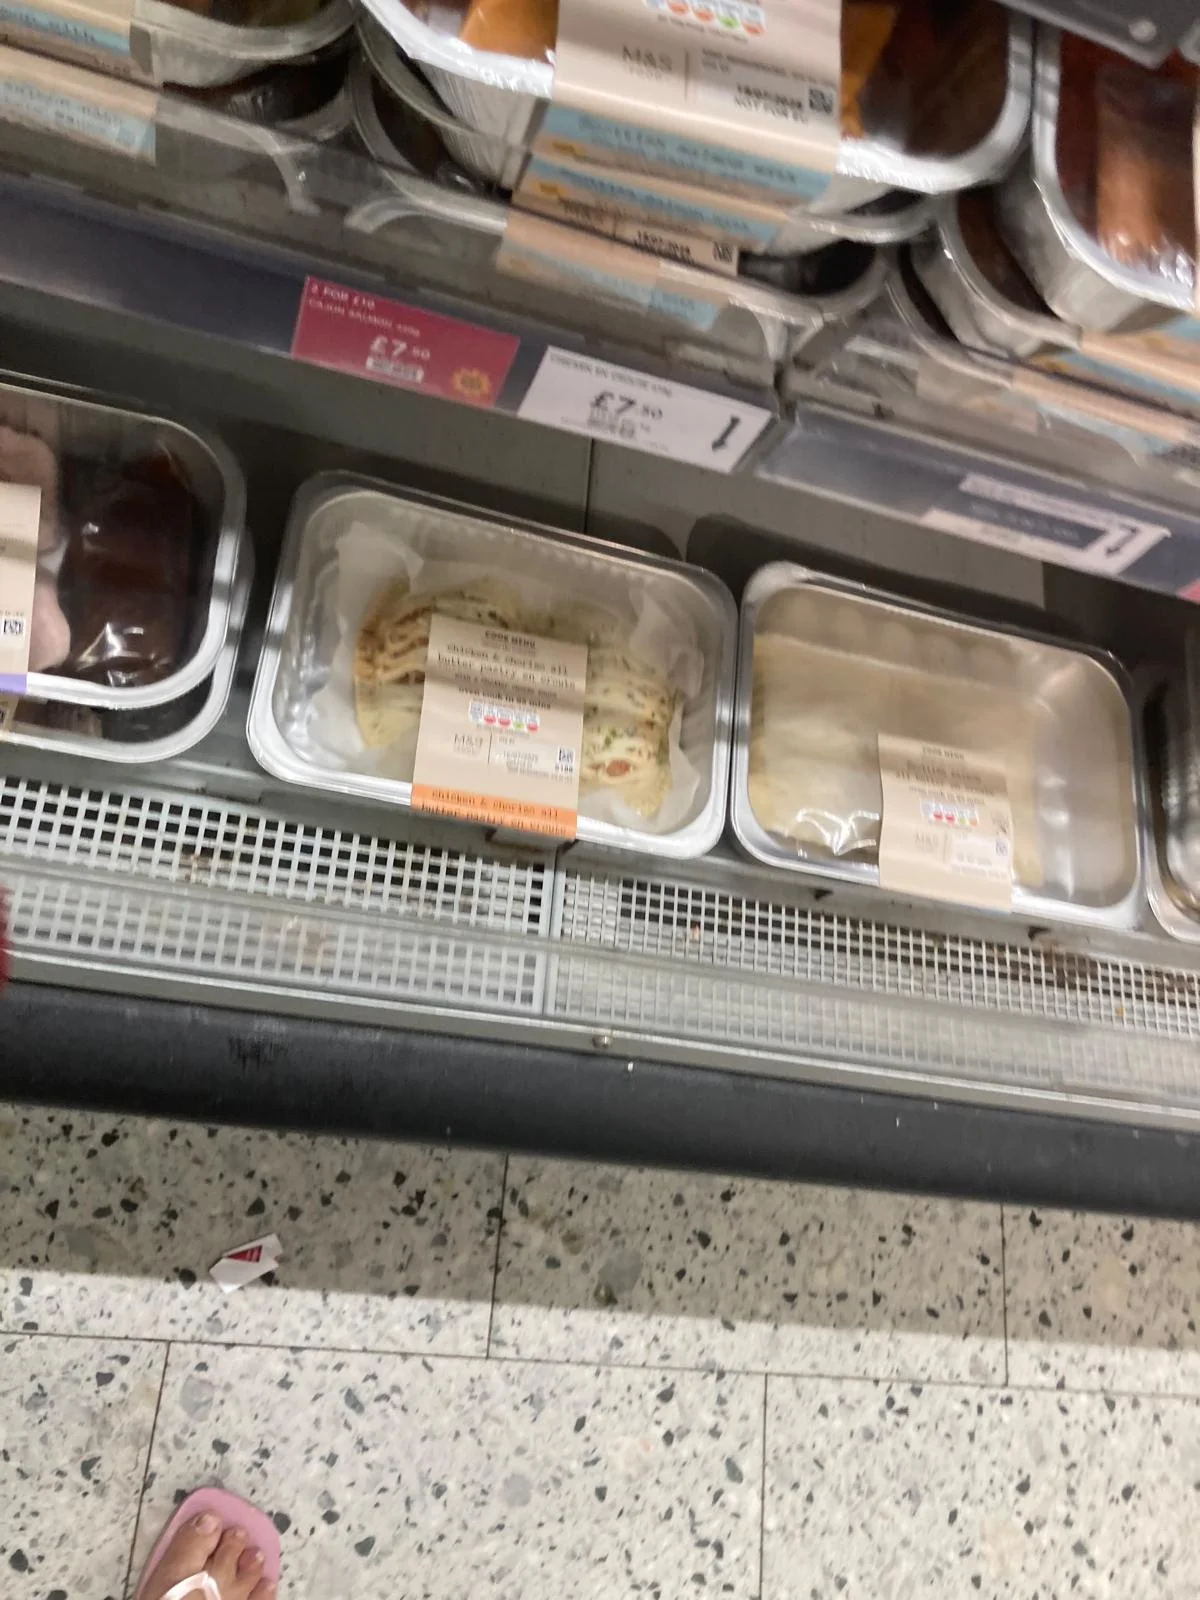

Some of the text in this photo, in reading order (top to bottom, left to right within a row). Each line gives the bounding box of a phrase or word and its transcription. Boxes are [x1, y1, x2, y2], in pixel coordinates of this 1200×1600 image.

[447, 643, 489, 659] chicken
[438, 652, 472, 670] butter
[480, 664, 517, 681] pastry
[432, 789, 475, 805] chicken
